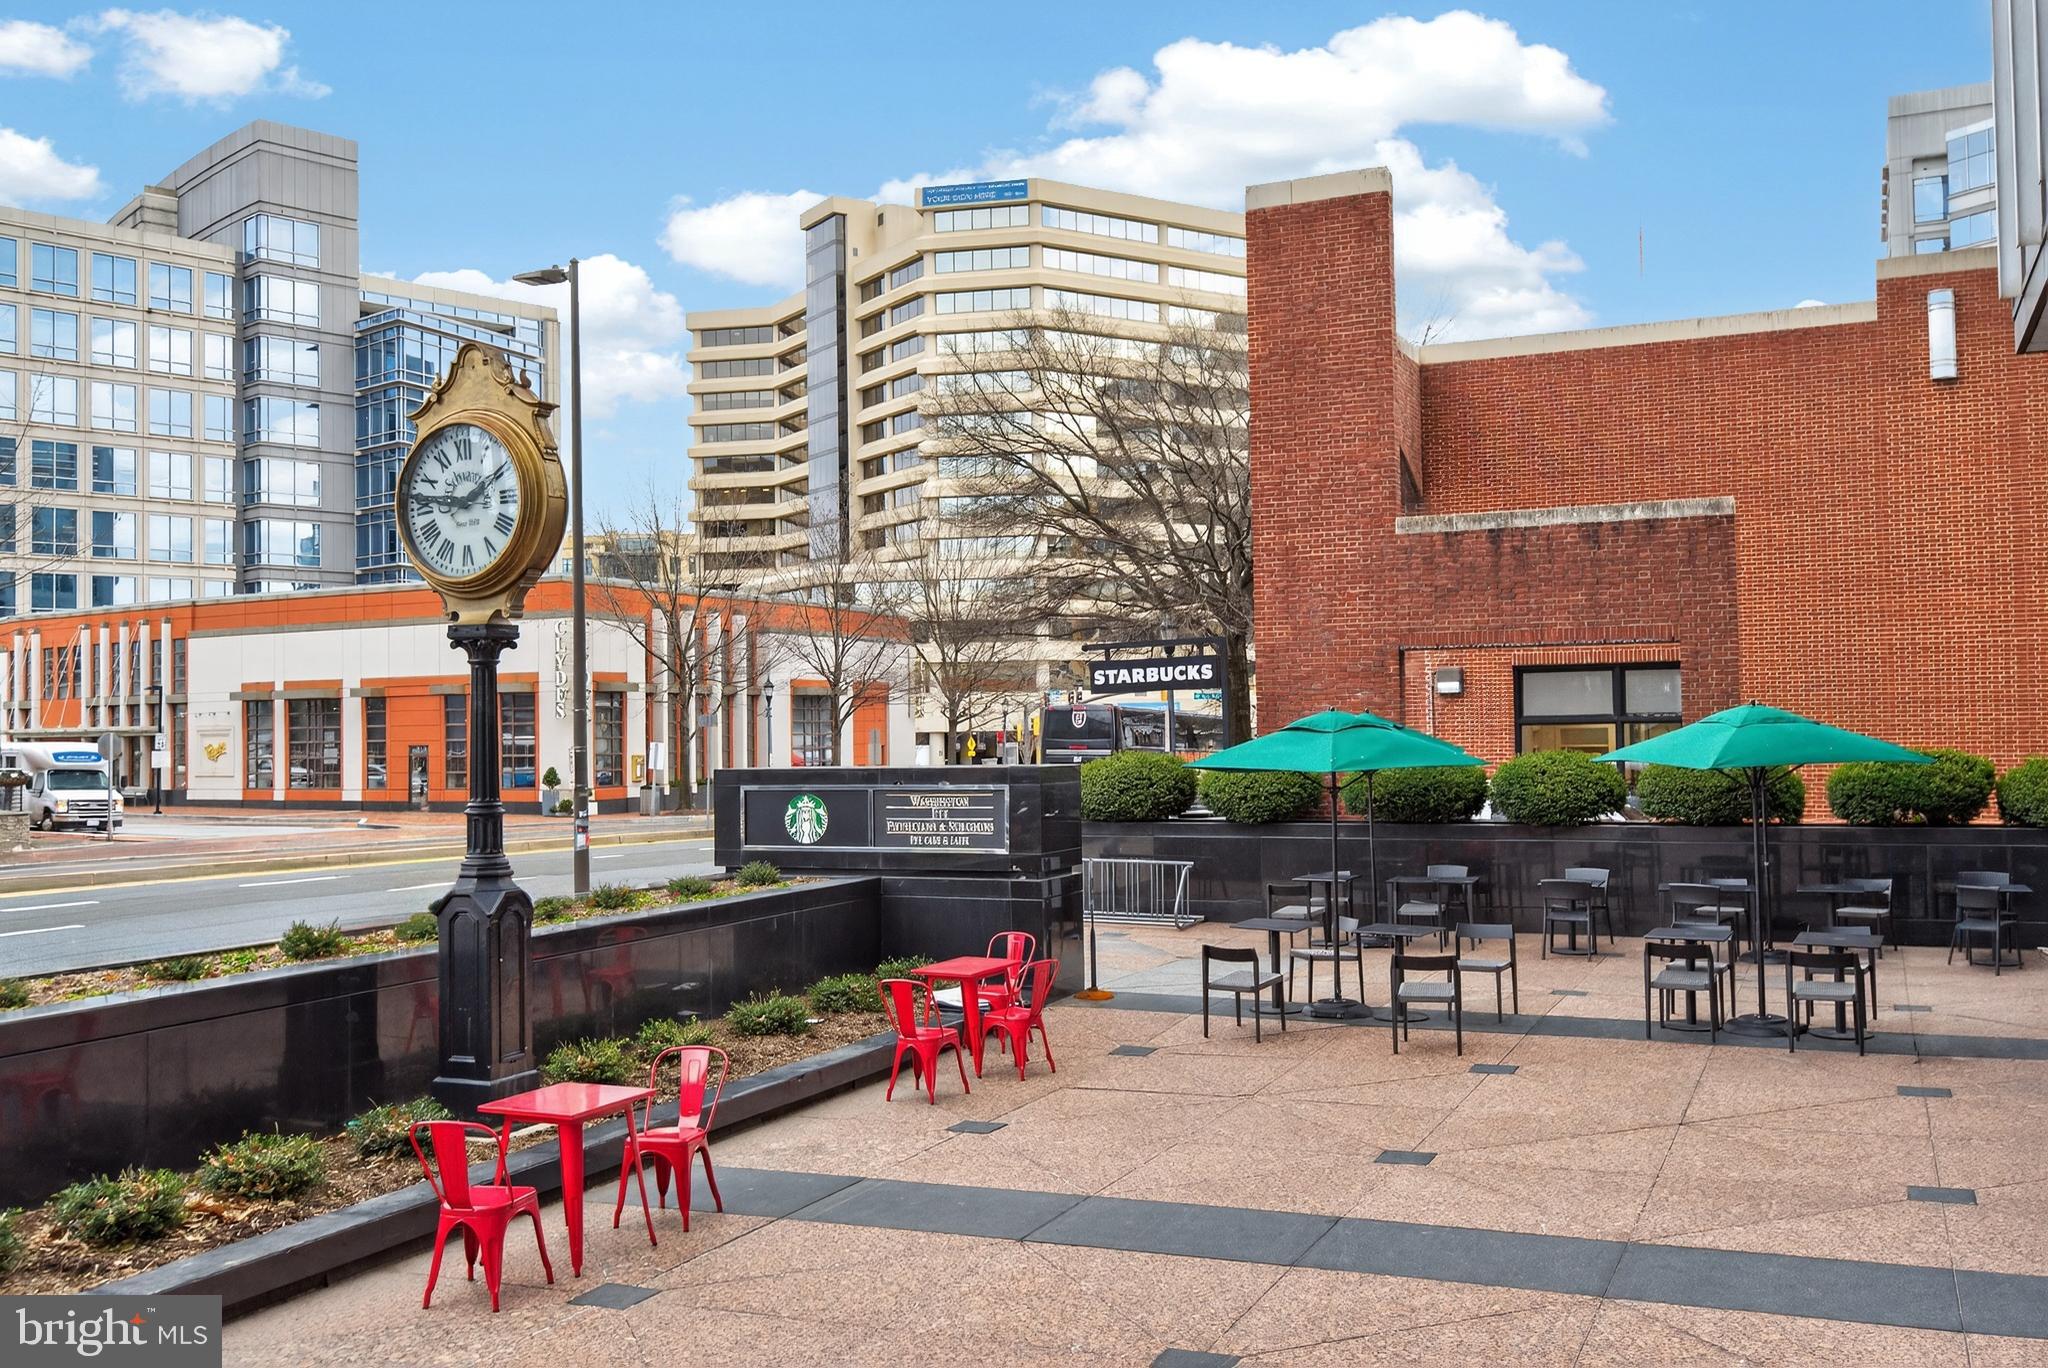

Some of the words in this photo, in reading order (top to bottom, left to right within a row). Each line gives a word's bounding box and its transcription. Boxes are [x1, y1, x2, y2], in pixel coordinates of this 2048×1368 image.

[434, 449, 452, 473] XI
[453, 438, 472, 462] XII
[420, 473, 439, 490] X
[1093, 663, 1214, 686] STARBUCKS
